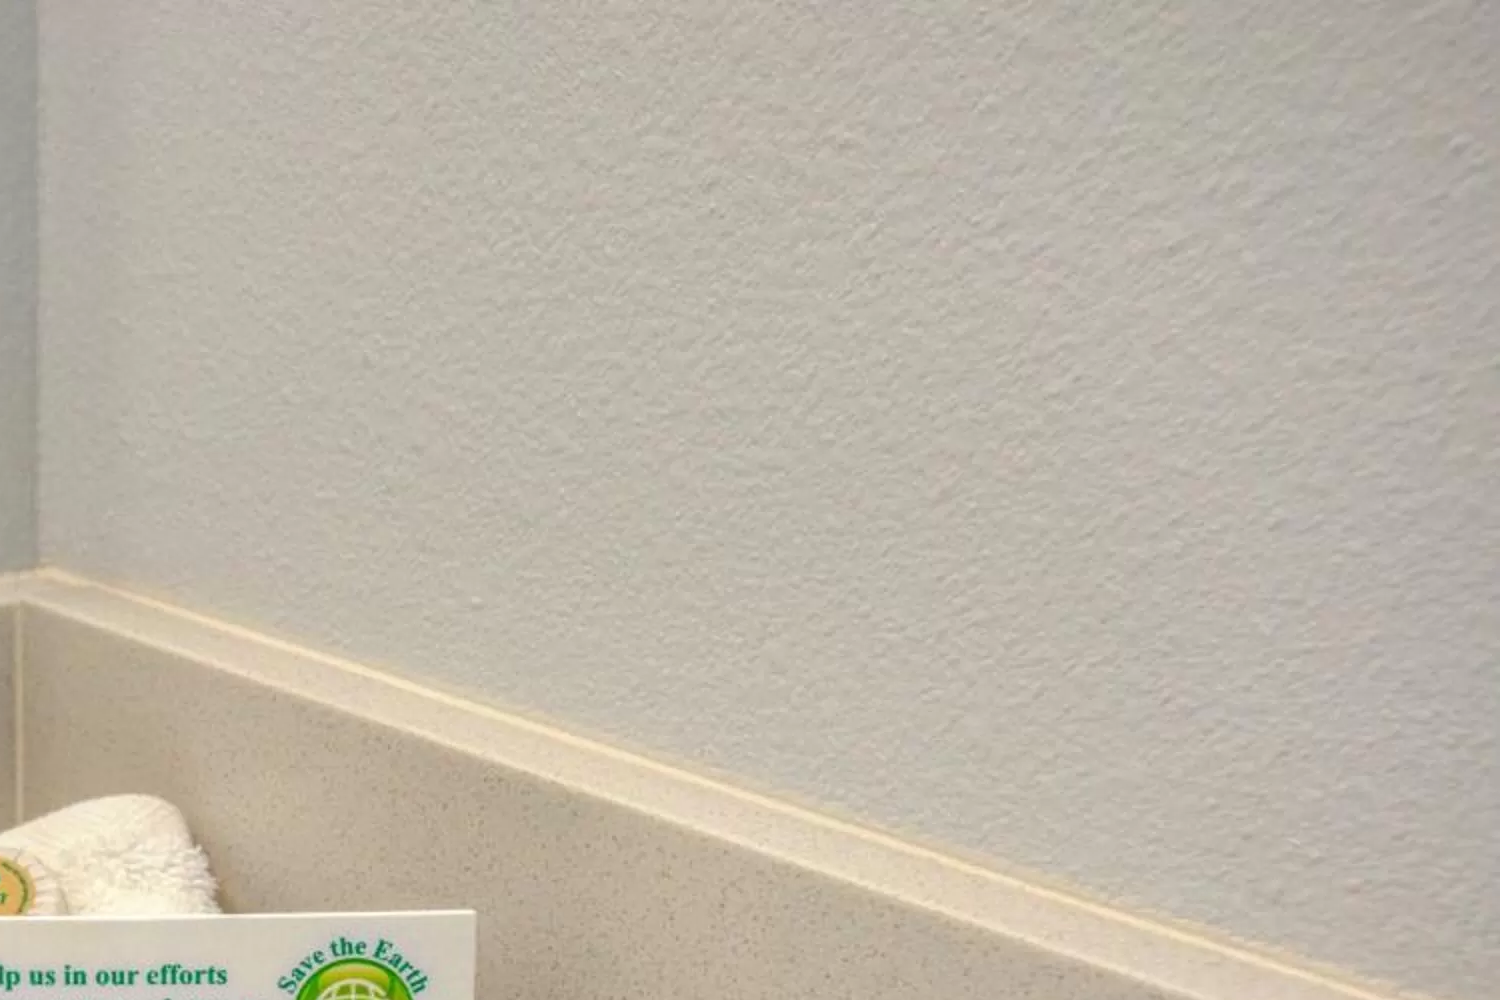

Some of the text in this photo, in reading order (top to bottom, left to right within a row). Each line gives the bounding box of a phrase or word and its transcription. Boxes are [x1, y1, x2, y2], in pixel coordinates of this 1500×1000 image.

[29, 970, 56, 986] us
[64, 964, 87, 986] in
[95, 970, 138, 986] our
[146, 963, 228, 986] efforts
[277, 937, 429, 995] Save the Earth
